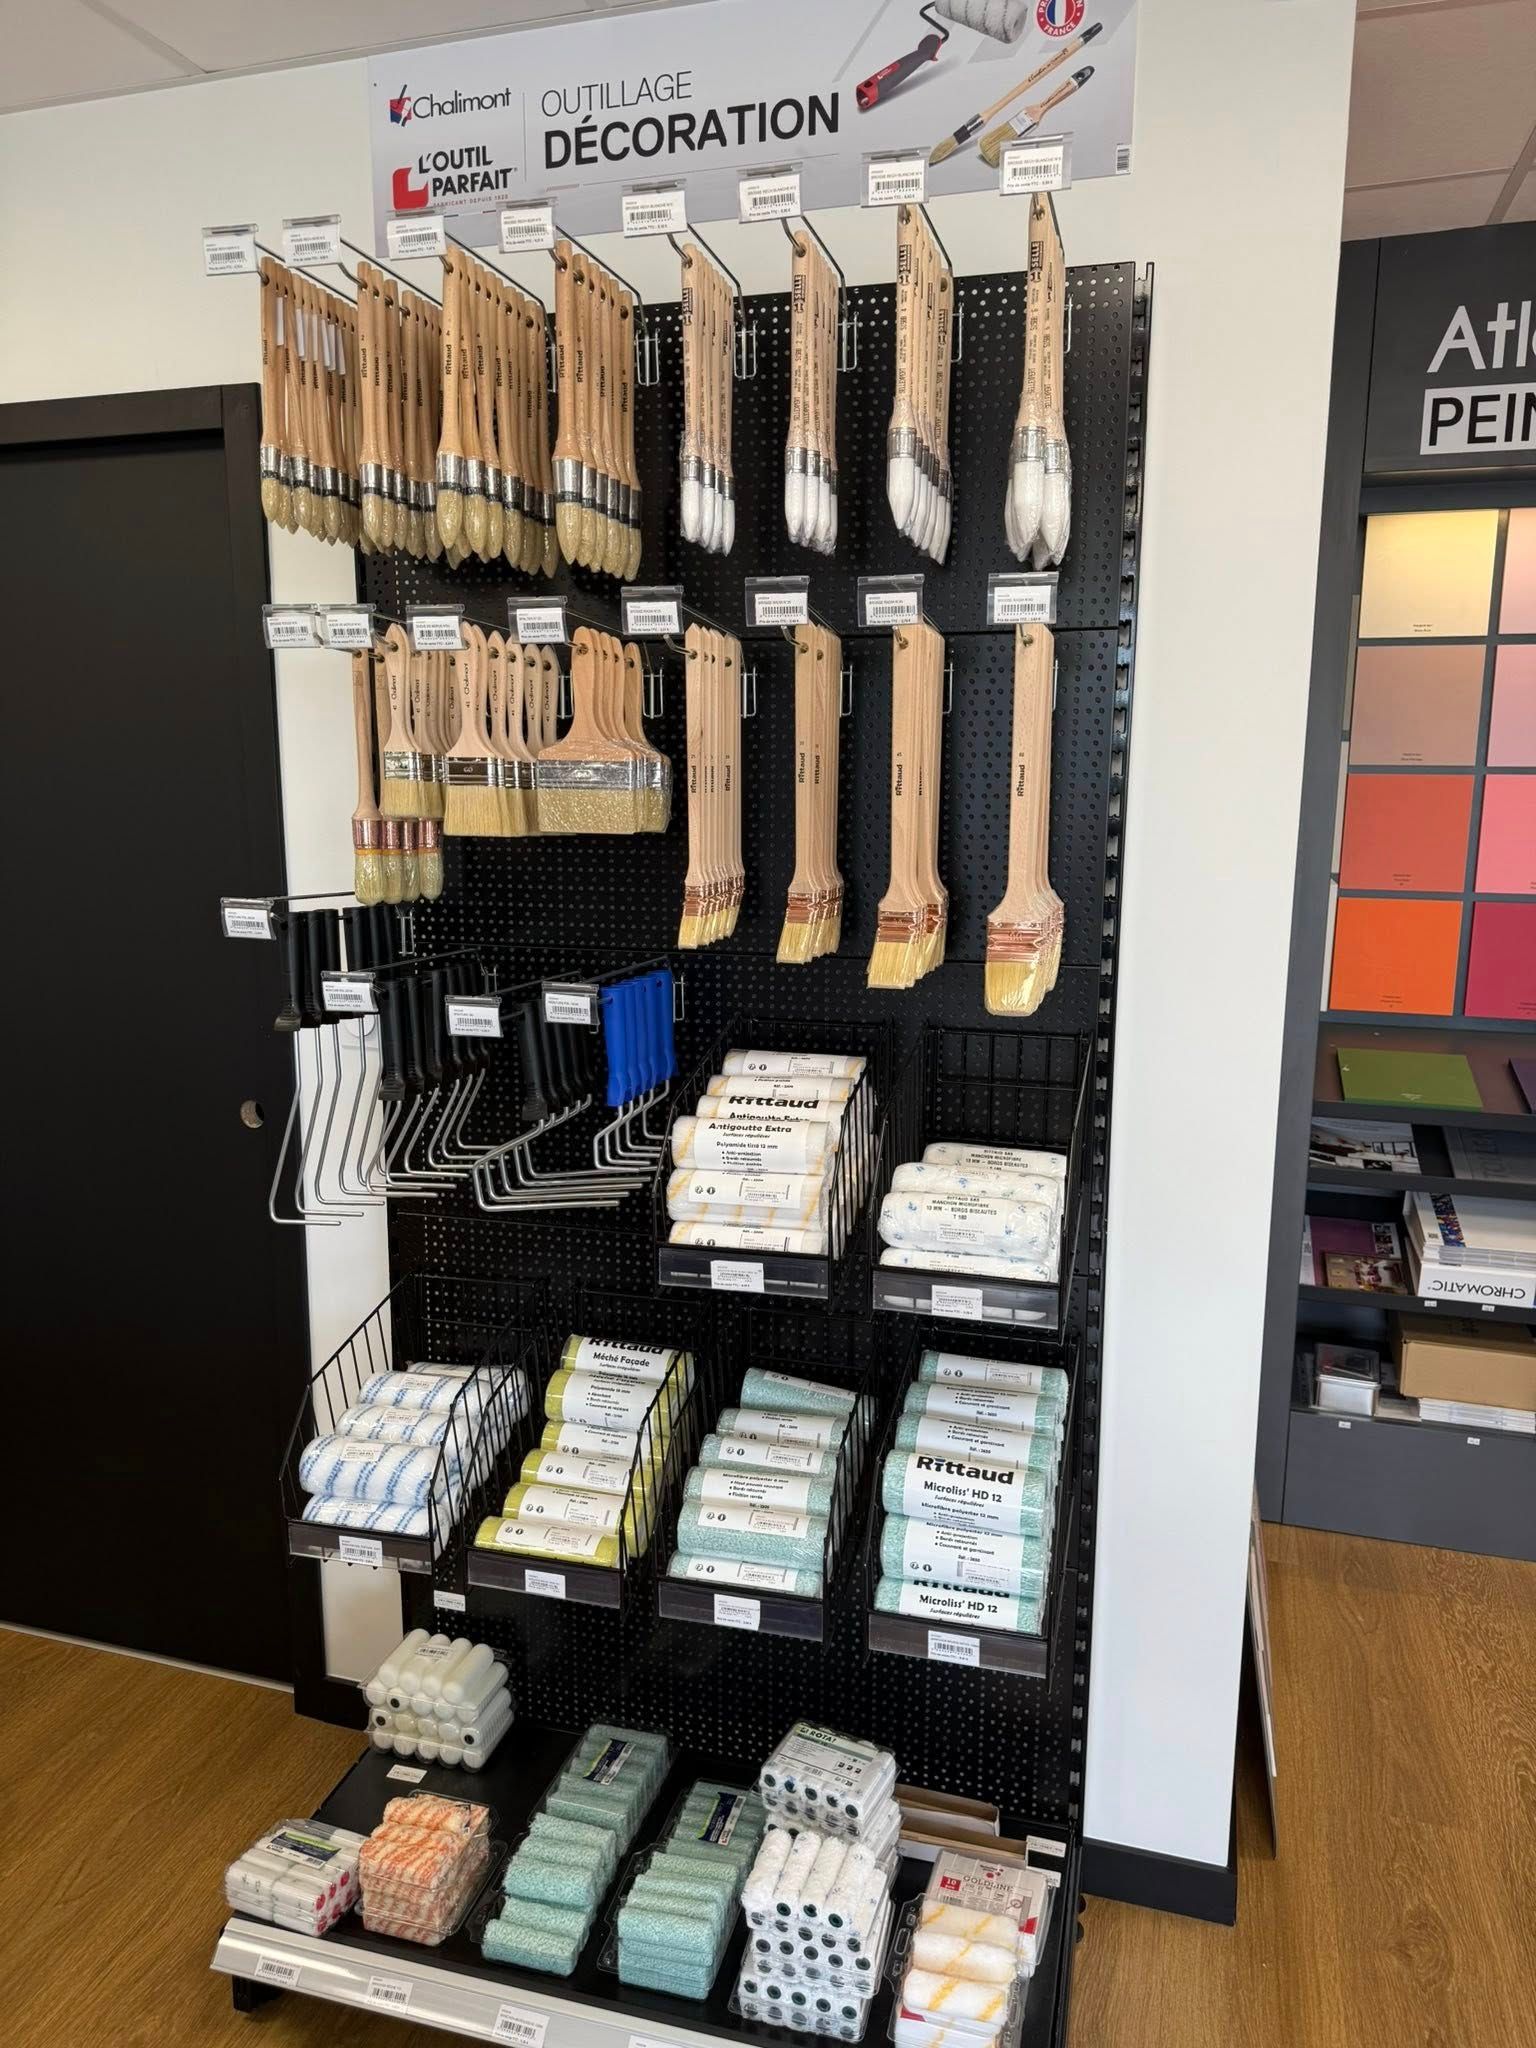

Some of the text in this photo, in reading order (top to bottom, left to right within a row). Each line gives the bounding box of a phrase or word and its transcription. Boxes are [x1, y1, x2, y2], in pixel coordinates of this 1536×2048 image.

[1043, 22, 1076, 35] FRANCE
[413, 87, 512, 119] Chalimont
[541, 70, 692, 118] OUTILLAGE
[544, 91, 840, 170] DÉCORATION
[418, 145, 494, 175] L'OUTIL
[432, 167, 514, 198] PARFAIT
[1426, 300, 1536, 373] Atl
[1017, 764, 1025, 797] Rittaud
[729, 1096, 820, 1110] Rittaud
[708, 1122, 792, 1133] Antigoutte Extra
[1432, 1279, 1526, 1299] CHROMATIC
[593, 1352, 650, 1367] Méché Façade
[916, 1456, 1014, 1485] Rittaud
[972, 1489, 989, 1500] HD
[992, 1494, 1003, 1503] 12
[967, 1601, 985, 1611] HD
[987, 1604, 998, 1613] 12
[963, 1875, 1014, 1892] GOLDLINE
